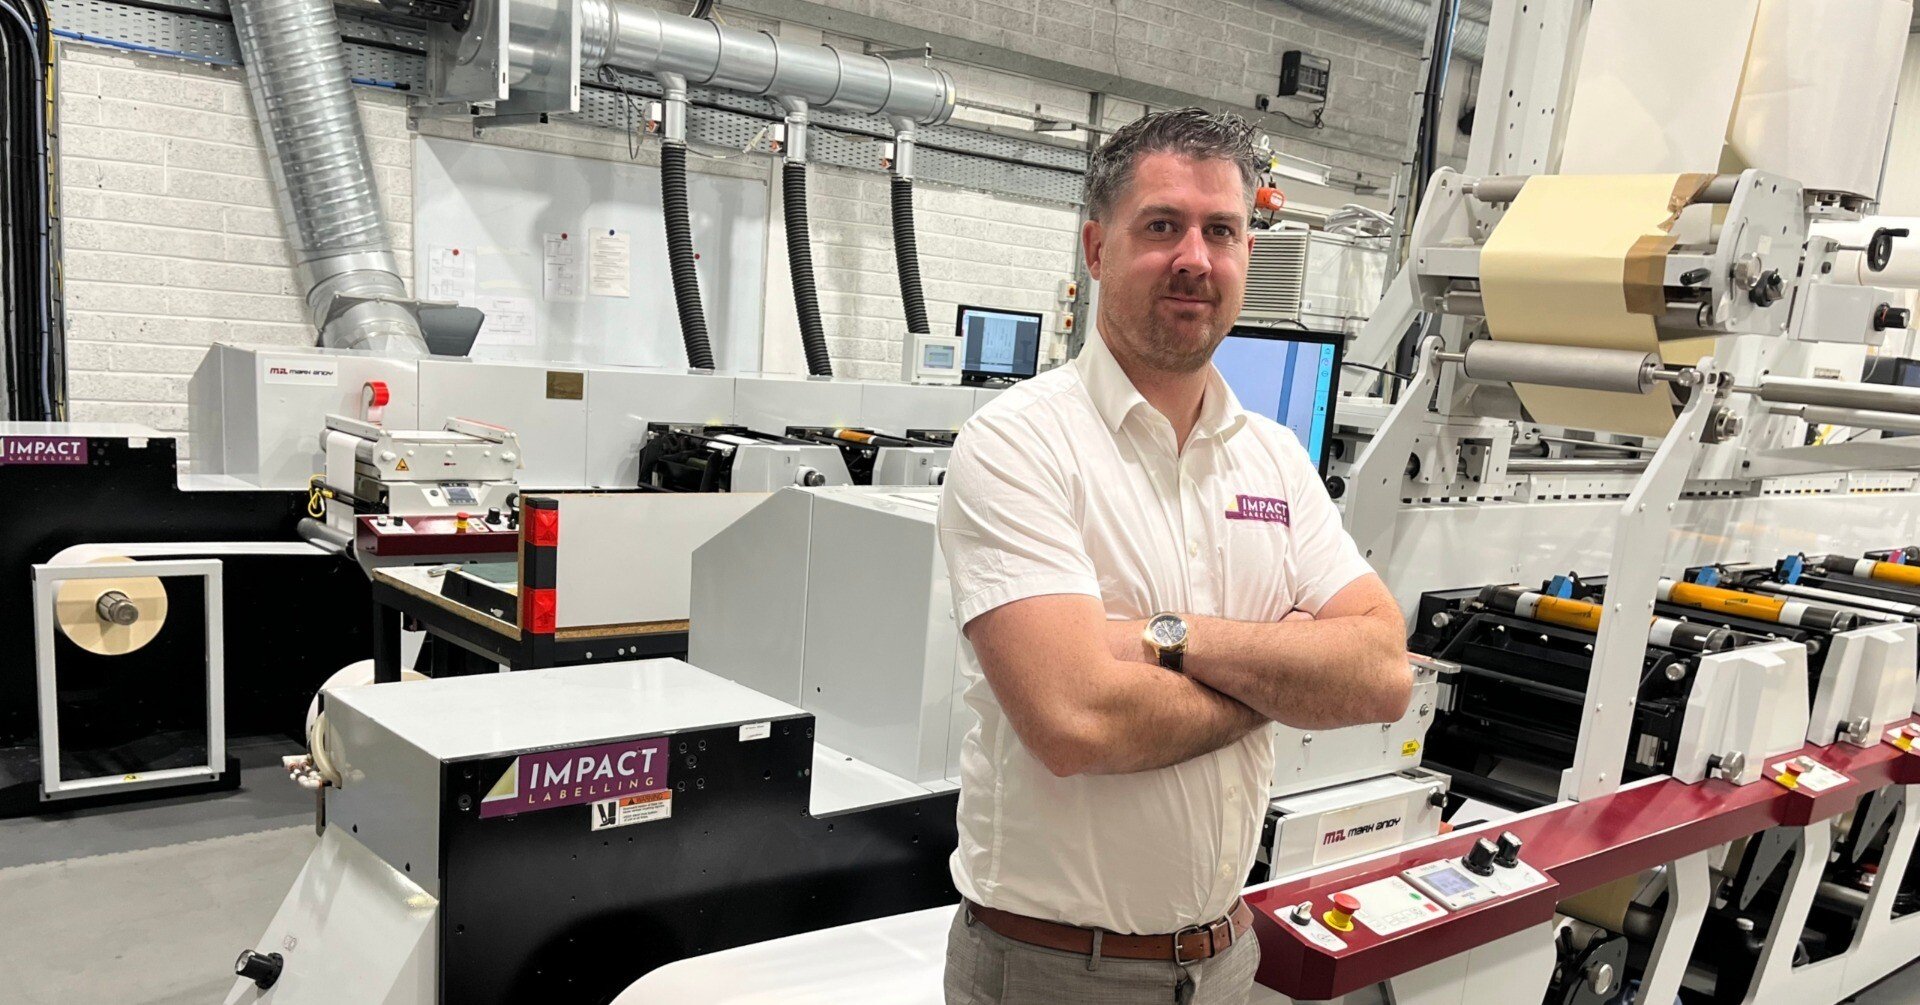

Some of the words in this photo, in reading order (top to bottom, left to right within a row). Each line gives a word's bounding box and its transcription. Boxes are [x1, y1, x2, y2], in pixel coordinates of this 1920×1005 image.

[9, 441, 81, 455] IMPACT
[1242, 498, 1287, 516] IMPACT
[530, 748, 657, 789] IMPACT
[528, 777, 654, 804] LABELLING
